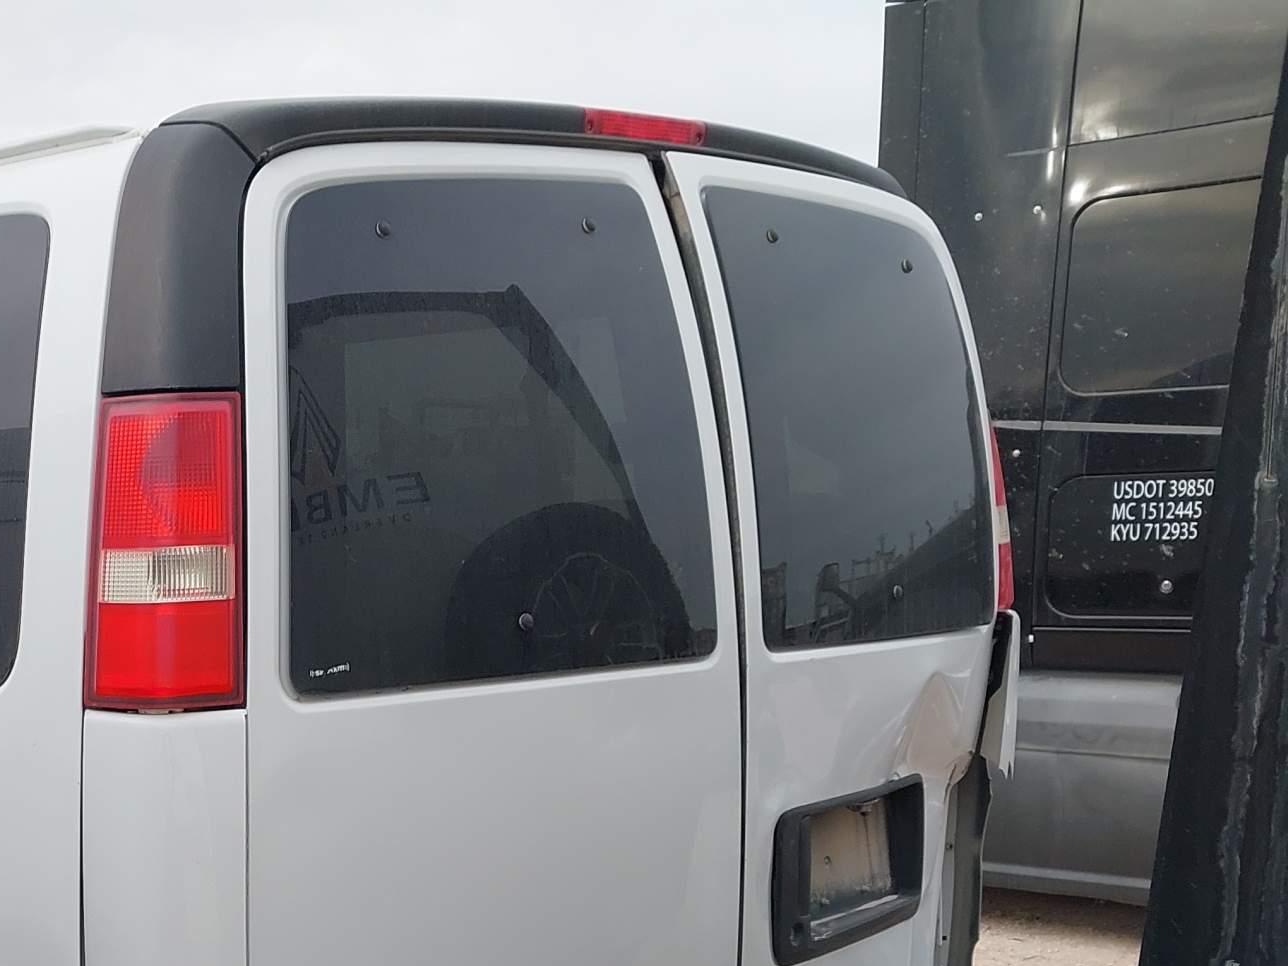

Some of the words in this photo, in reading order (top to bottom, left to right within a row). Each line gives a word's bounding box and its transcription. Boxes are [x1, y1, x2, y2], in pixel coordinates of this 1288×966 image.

[1113, 479, 1167, 500] USDOT
[1168, 478, 1215, 498] 39850
[1111, 501, 1137, 521] MC
[1140, 500, 1203, 520] 1512445
[1110, 522, 1141, 542] KYU
[1144, 521, 1199, 541] 712935
